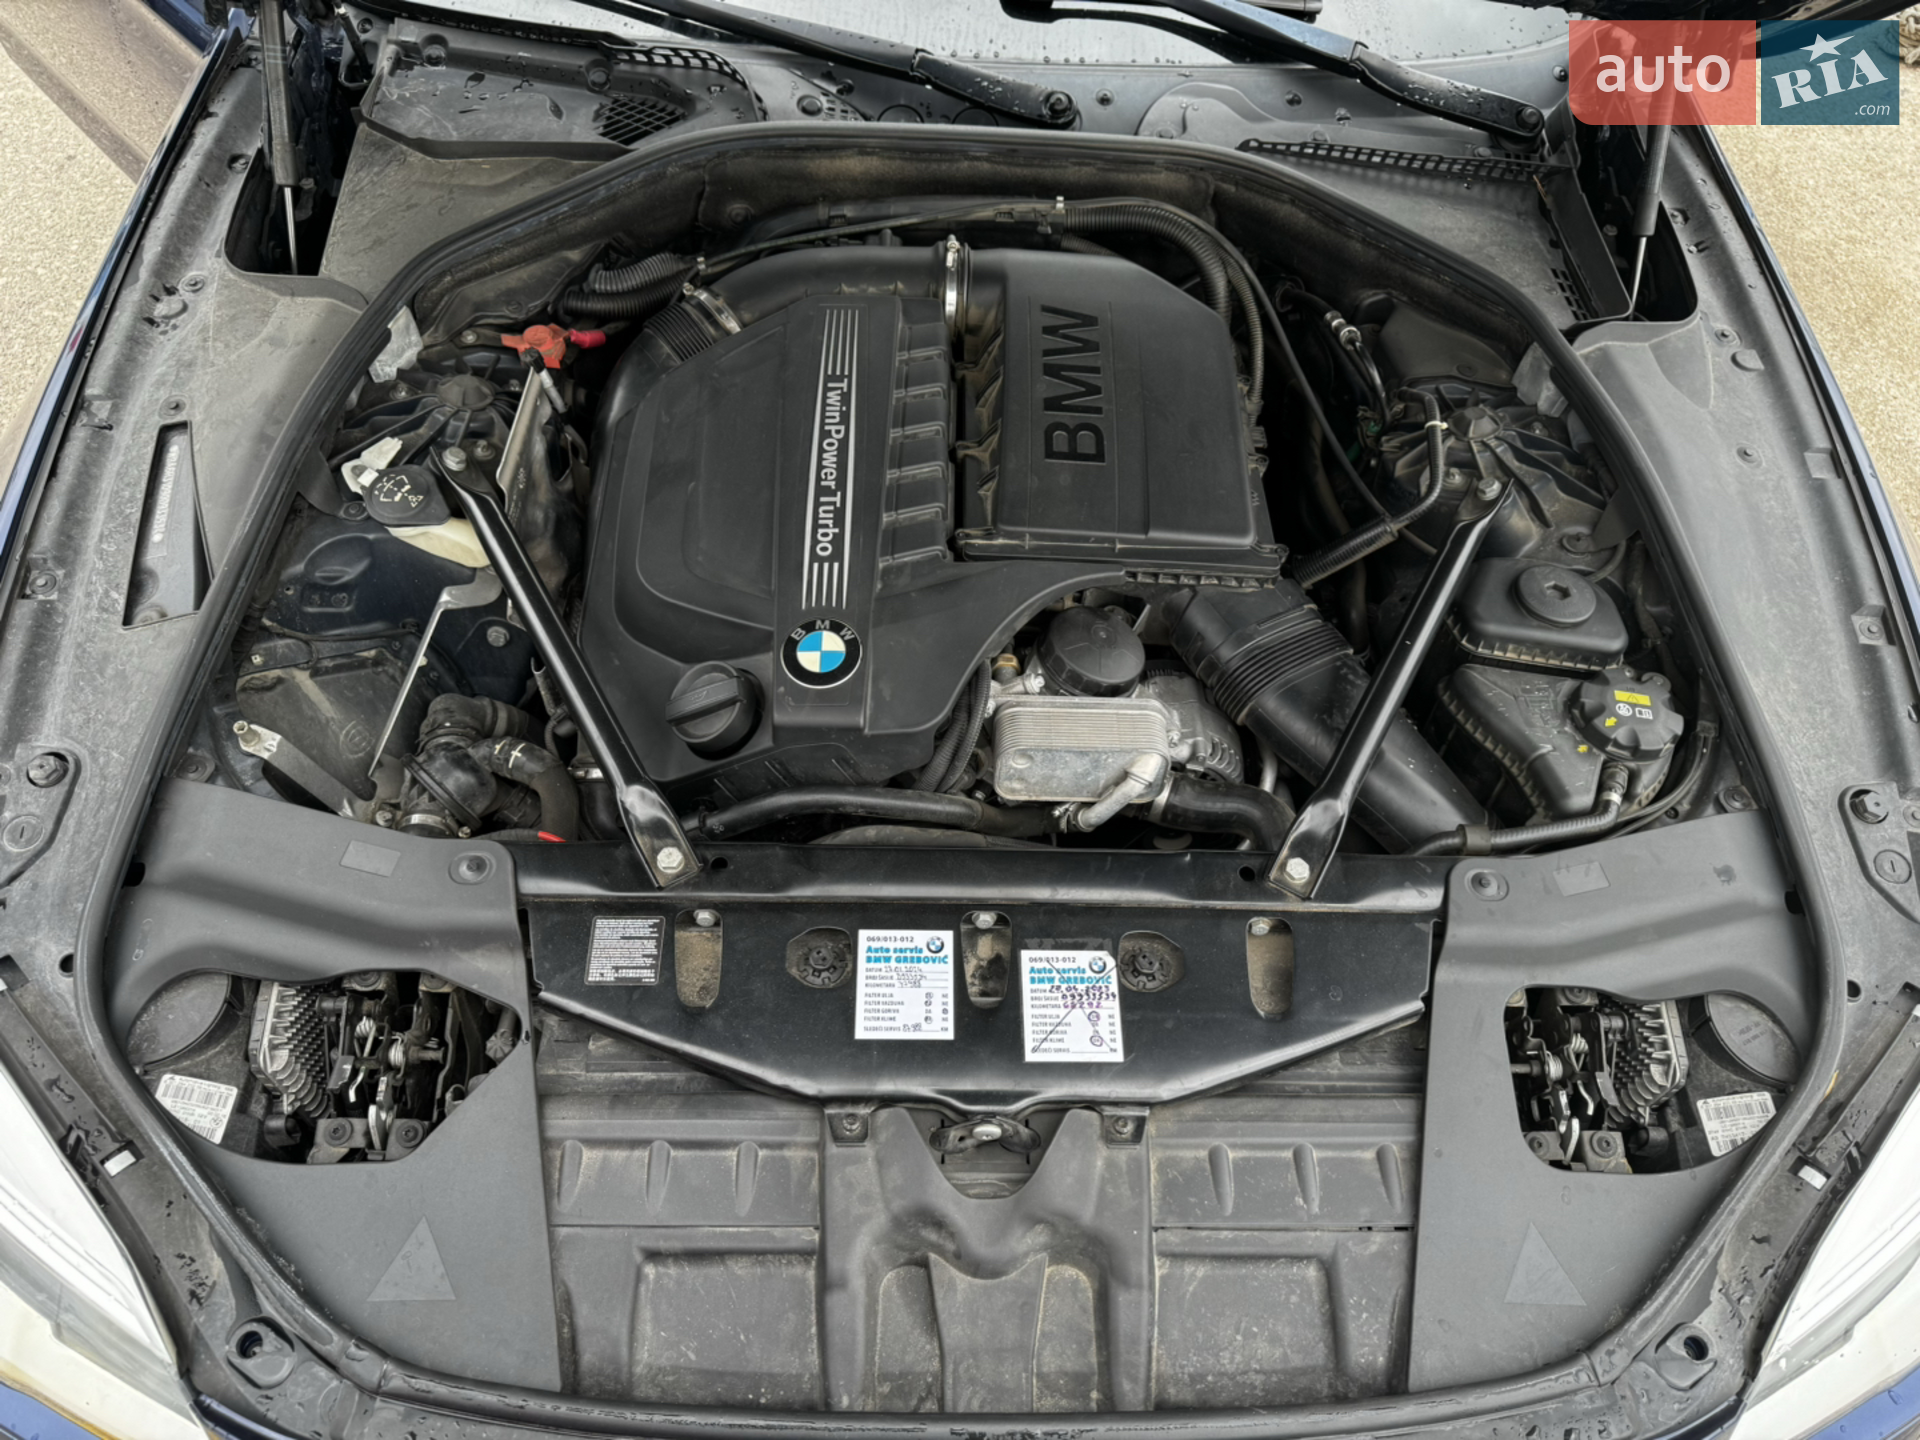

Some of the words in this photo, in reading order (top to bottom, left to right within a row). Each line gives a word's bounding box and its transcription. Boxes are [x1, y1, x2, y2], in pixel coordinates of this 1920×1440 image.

[1040, 304, 1106, 466] BMW
[819, 377, 848, 490] TwinPower
[816, 491, 842, 557] Turbo
[790, 619, 856, 641] BMW
[866, 946, 890, 954] Auto
[893, 946, 924, 954] servis
[866, 956, 892, 964] BMW
[895, 955, 949, 964] GREBOVIĆ
[1029, 967, 1054, 975] Auto
[1029, 976, 1055, 984] BMW
